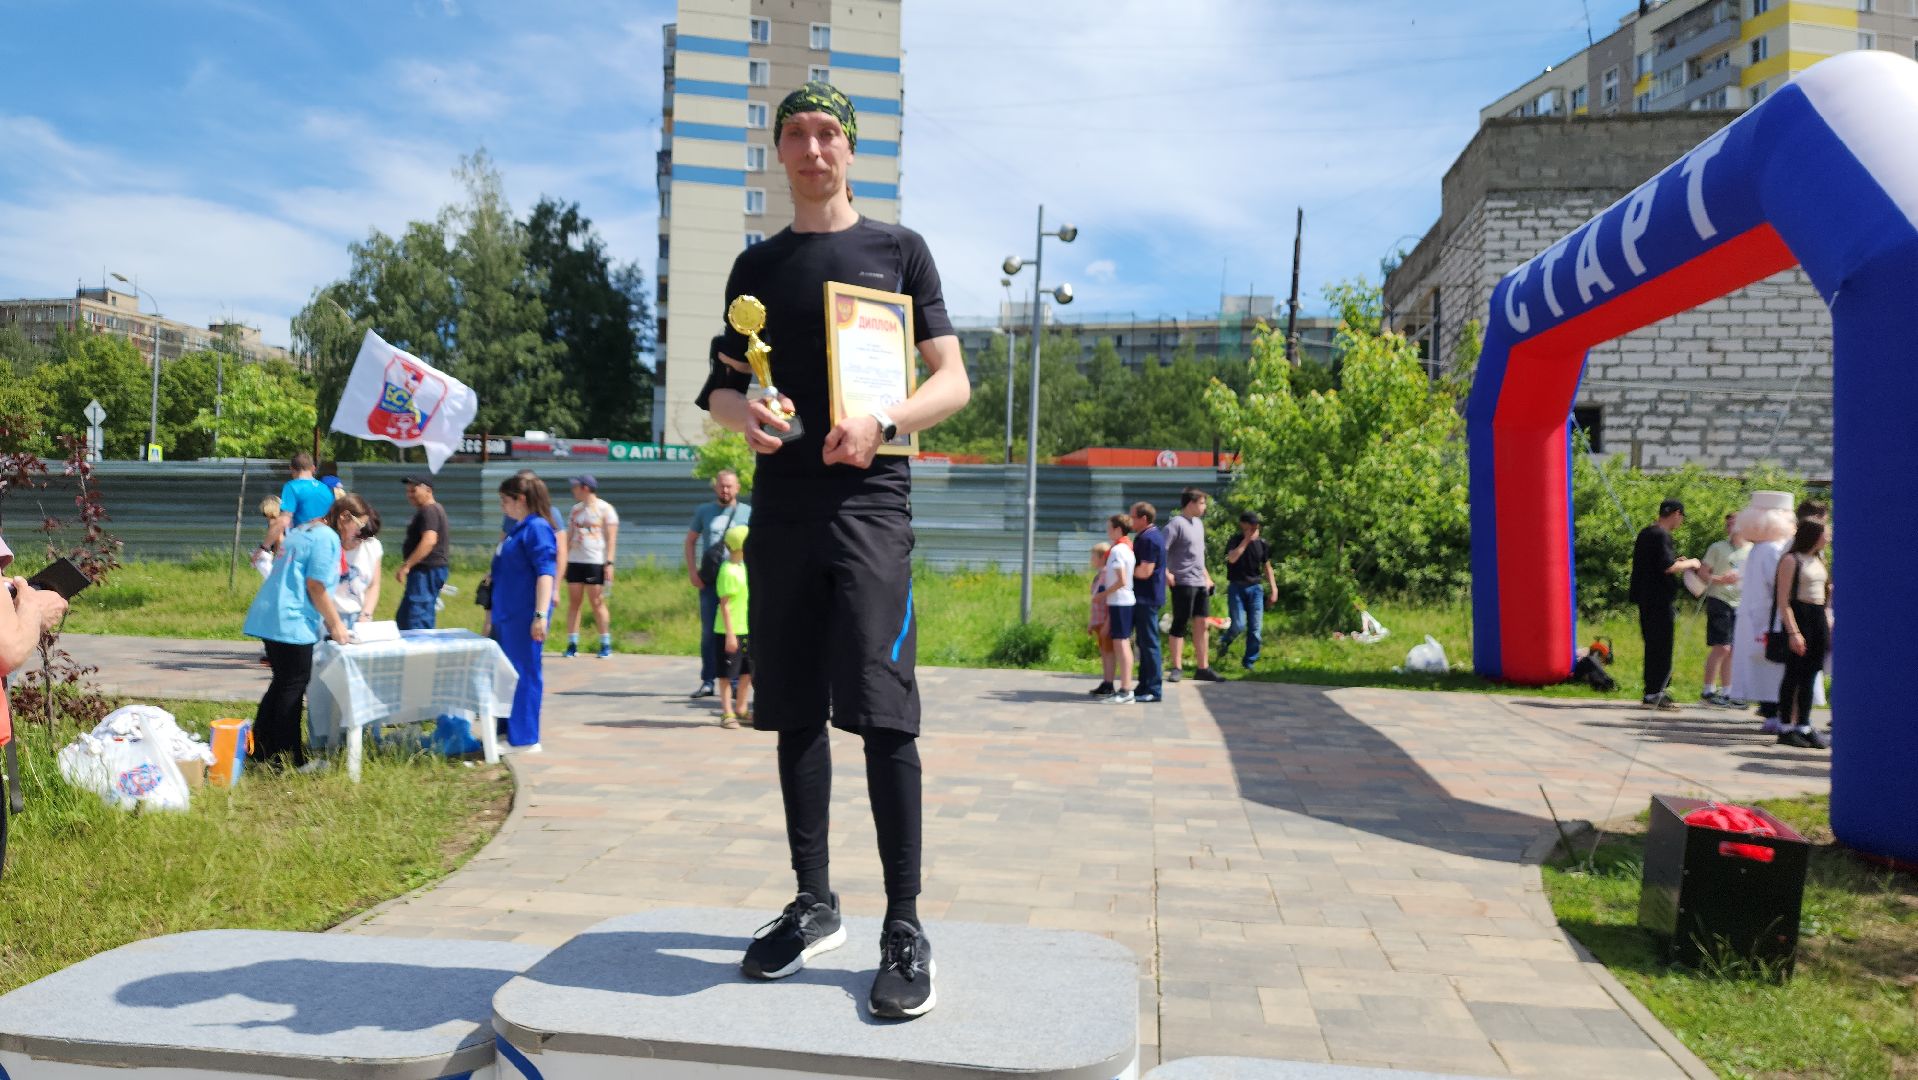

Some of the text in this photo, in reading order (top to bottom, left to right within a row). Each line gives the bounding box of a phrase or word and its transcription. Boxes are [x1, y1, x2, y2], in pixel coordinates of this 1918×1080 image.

[1505, 128, 1730, 333] СТАРТ
[858, 316, 897, 333] ДИПЛОМ
[629, 446, 697, 461] АПТЕК
